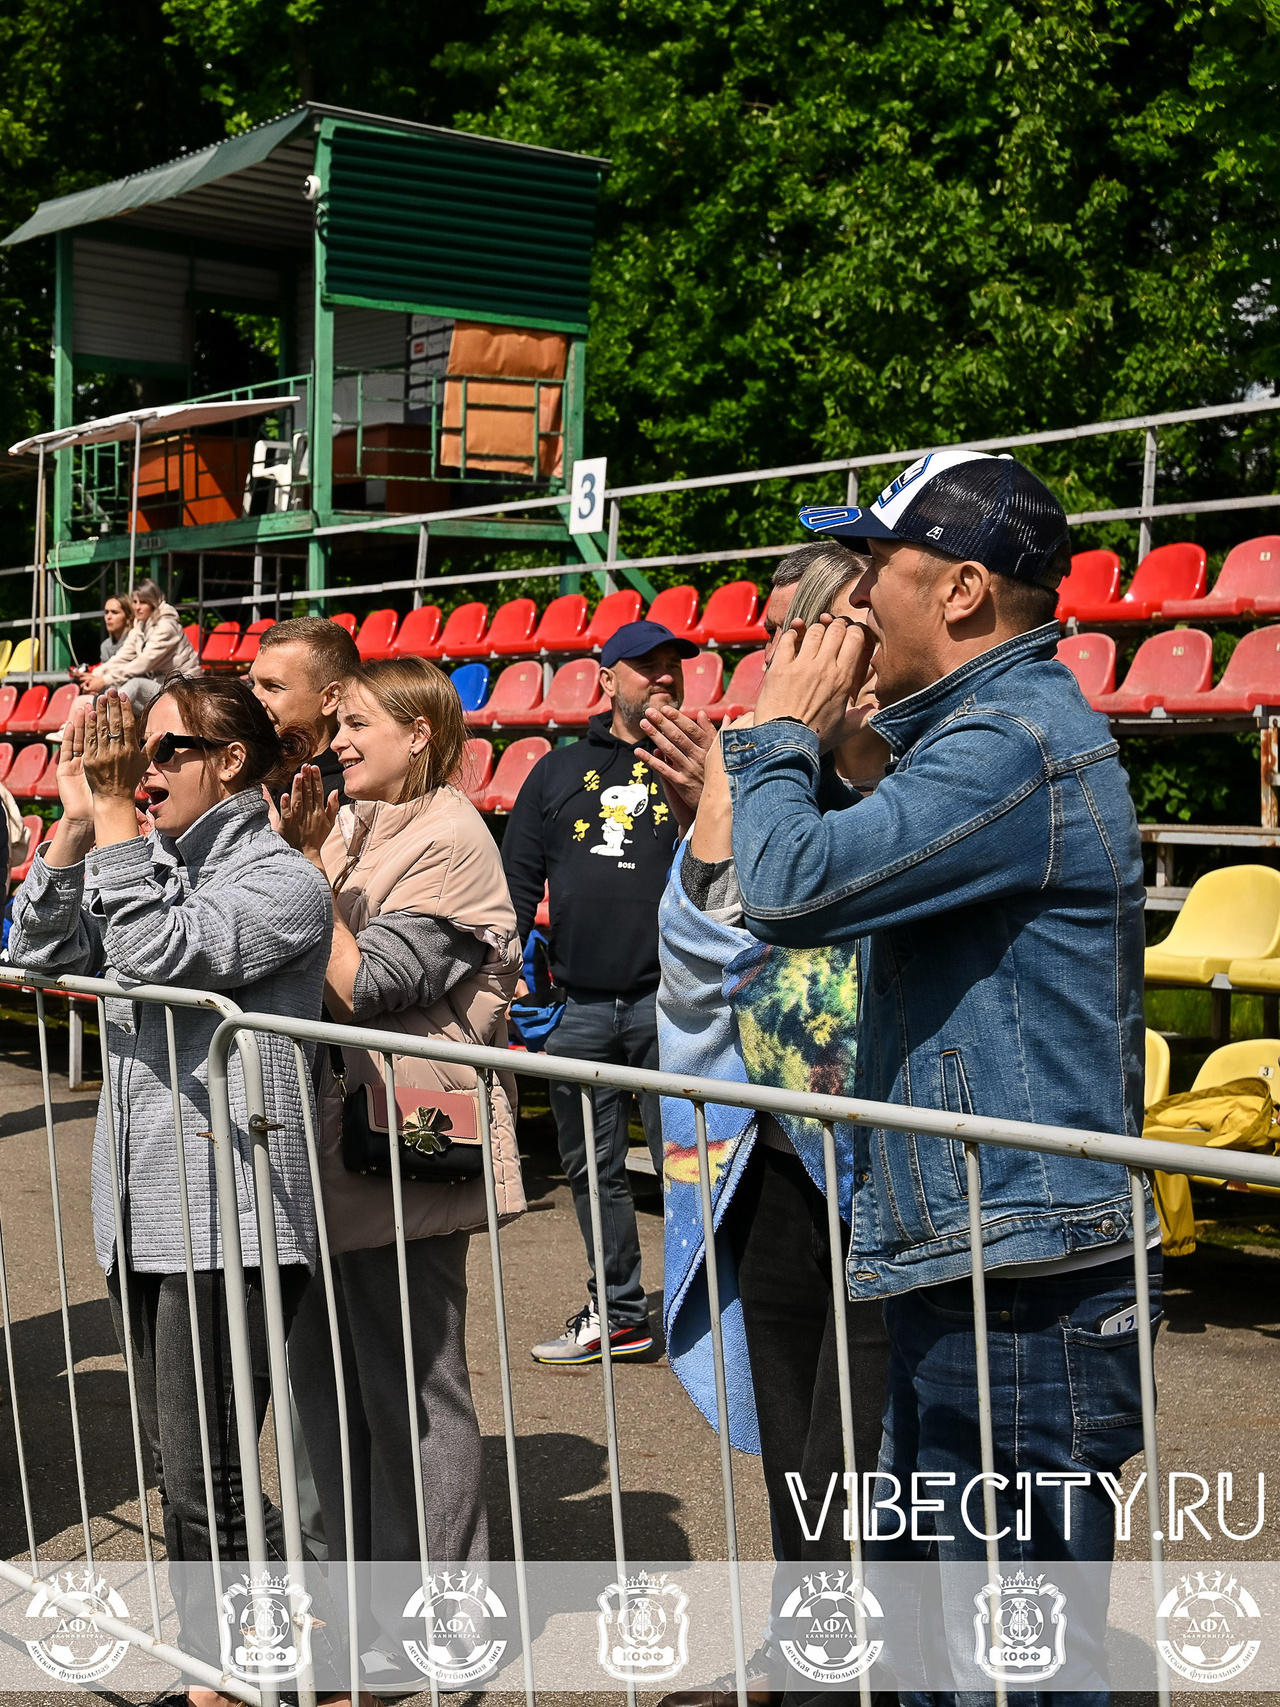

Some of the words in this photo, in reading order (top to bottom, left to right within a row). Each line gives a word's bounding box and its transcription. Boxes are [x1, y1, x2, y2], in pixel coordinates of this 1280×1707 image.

[578, 473, 596, 519] 3
[617, 861, 636, 869] BOSS
[1262, 1066, 1270, 1077] 3
